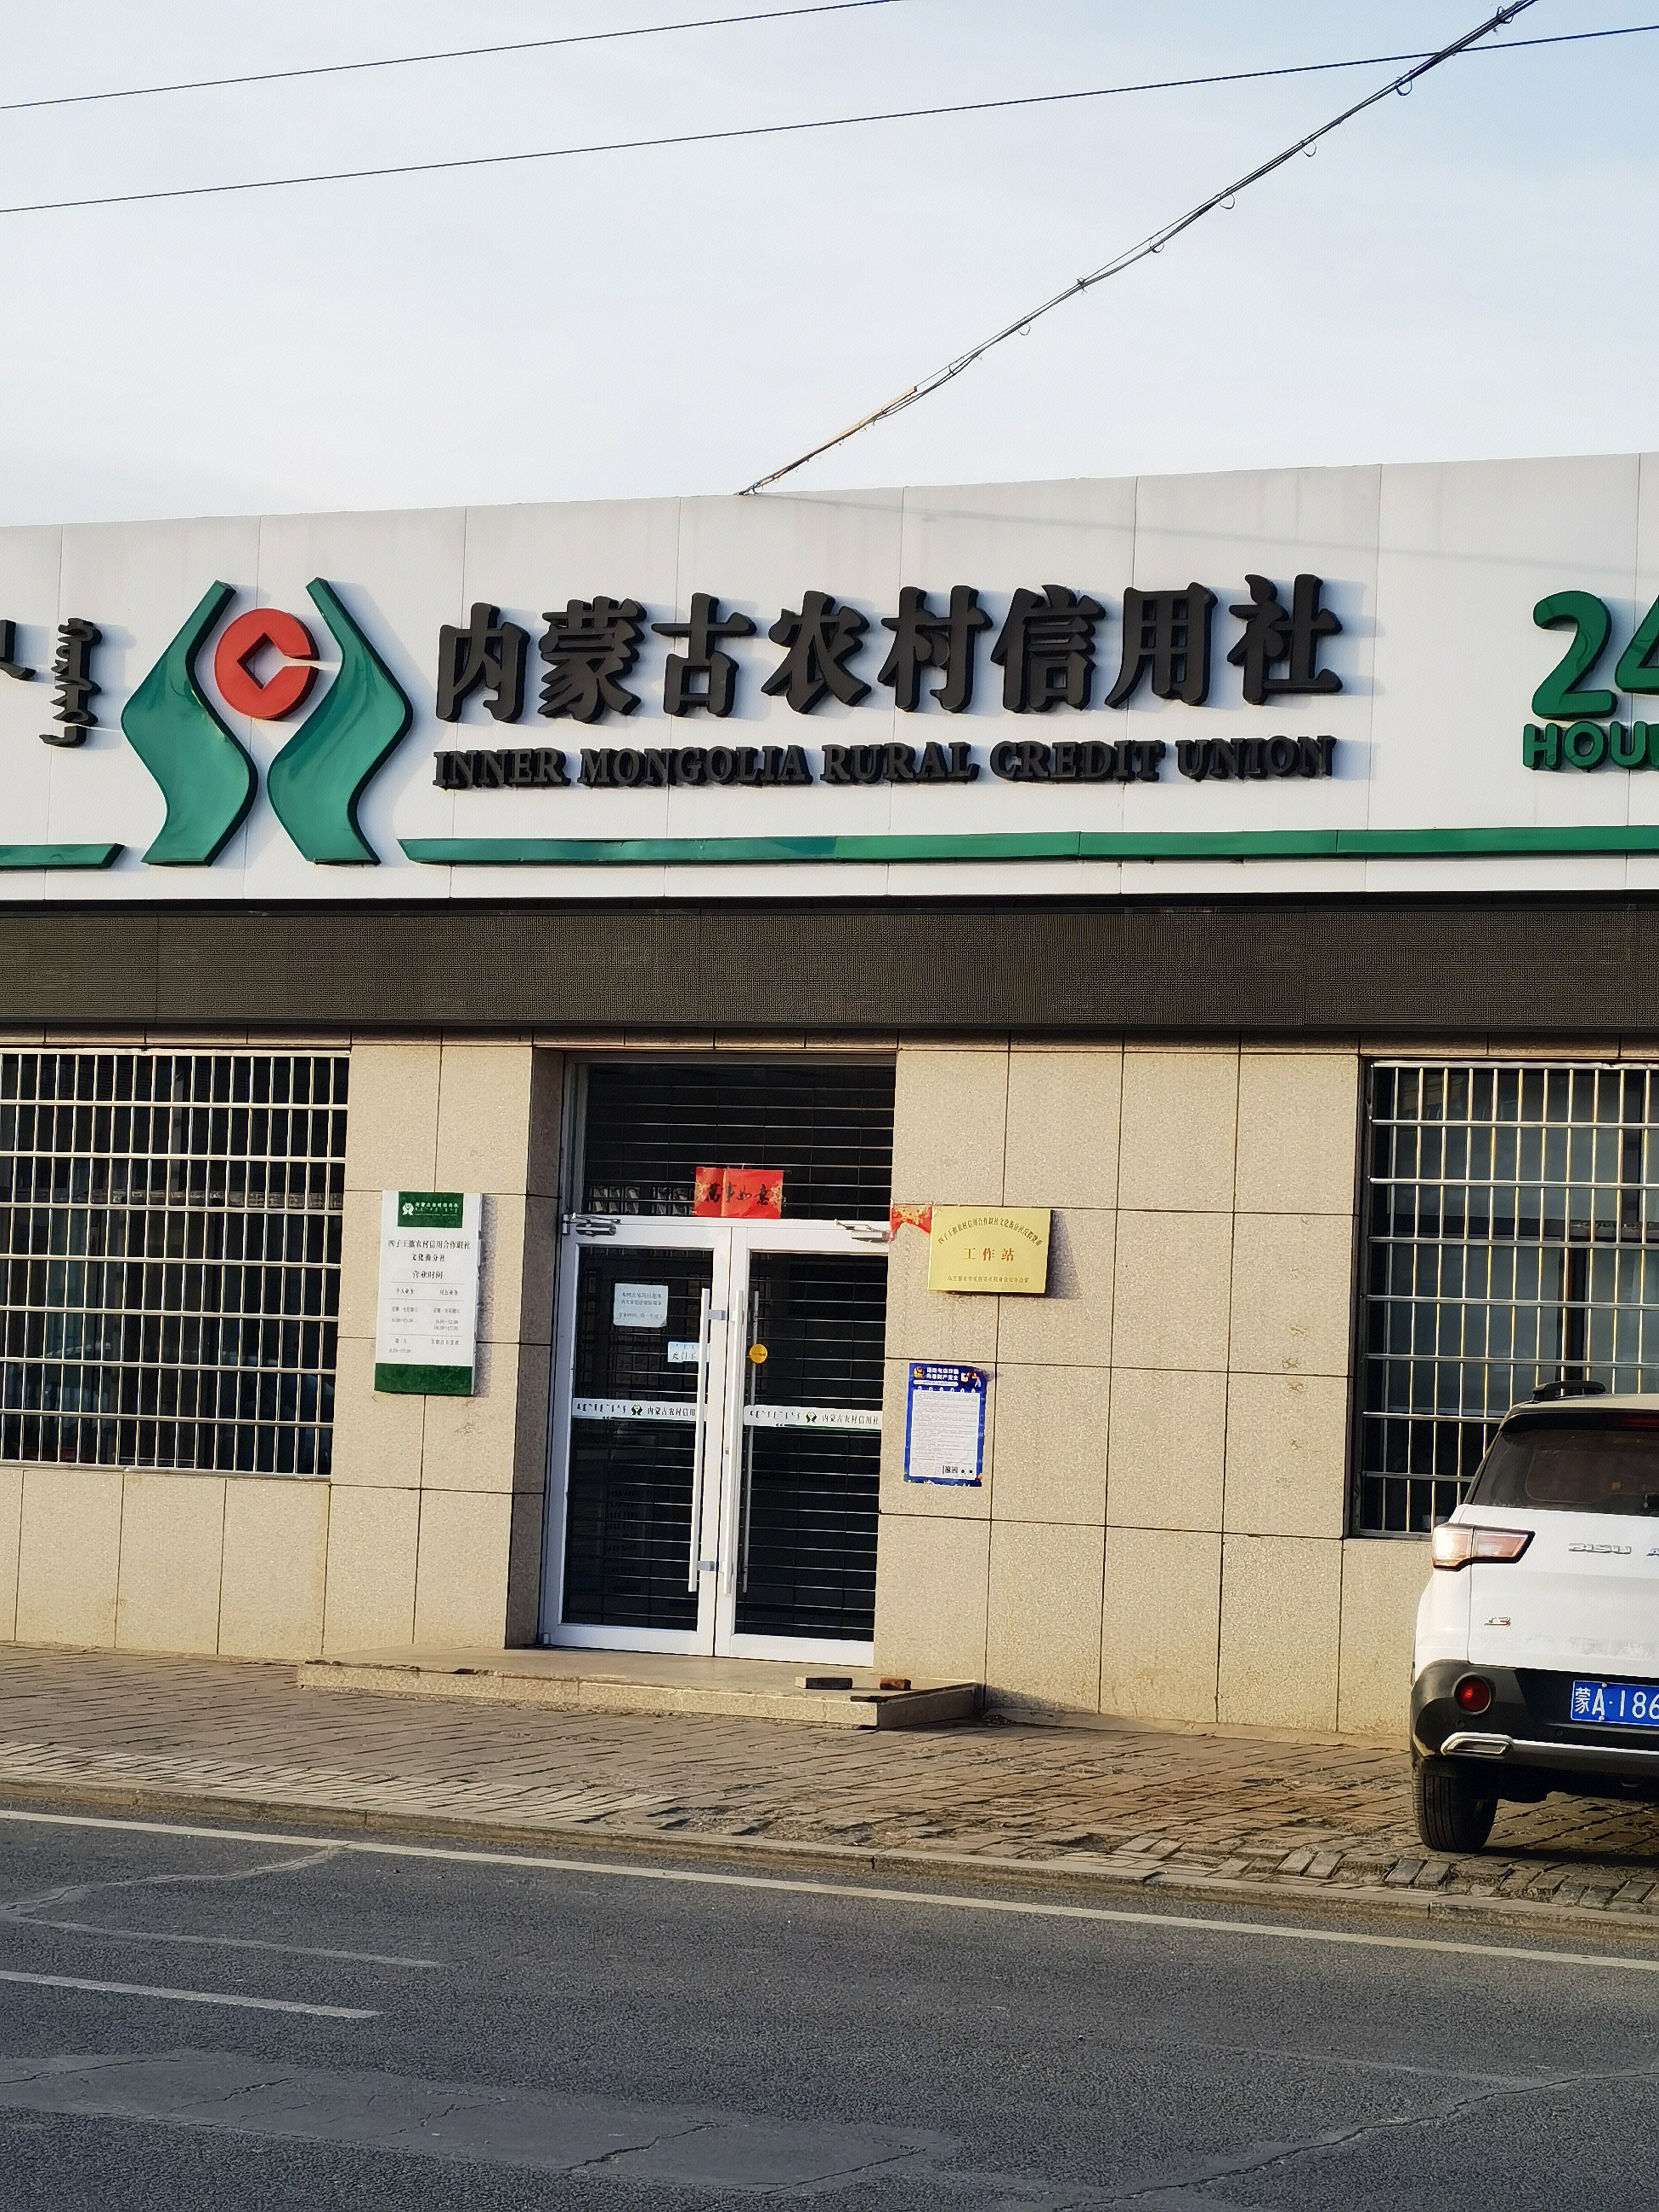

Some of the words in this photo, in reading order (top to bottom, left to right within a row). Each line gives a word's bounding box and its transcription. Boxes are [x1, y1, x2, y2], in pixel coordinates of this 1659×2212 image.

[436, 574, 1343, 723] 内蒙古农村信用社
[433, 747, 570, 790] INNER
[578, 745, 813, 787] MONGOLIA
[820, 741, 981, 785] RURAL
[989, 739, 1166, 782] CREDIT
[1176, 735, 1337, 781] UNION
[962, 1247, 1014, 1262] 工作站
[648, 1406, 696, 1417] 内蒙古农村信用
[821, 1413, 879, 1425] 内蒙古农村信用社
